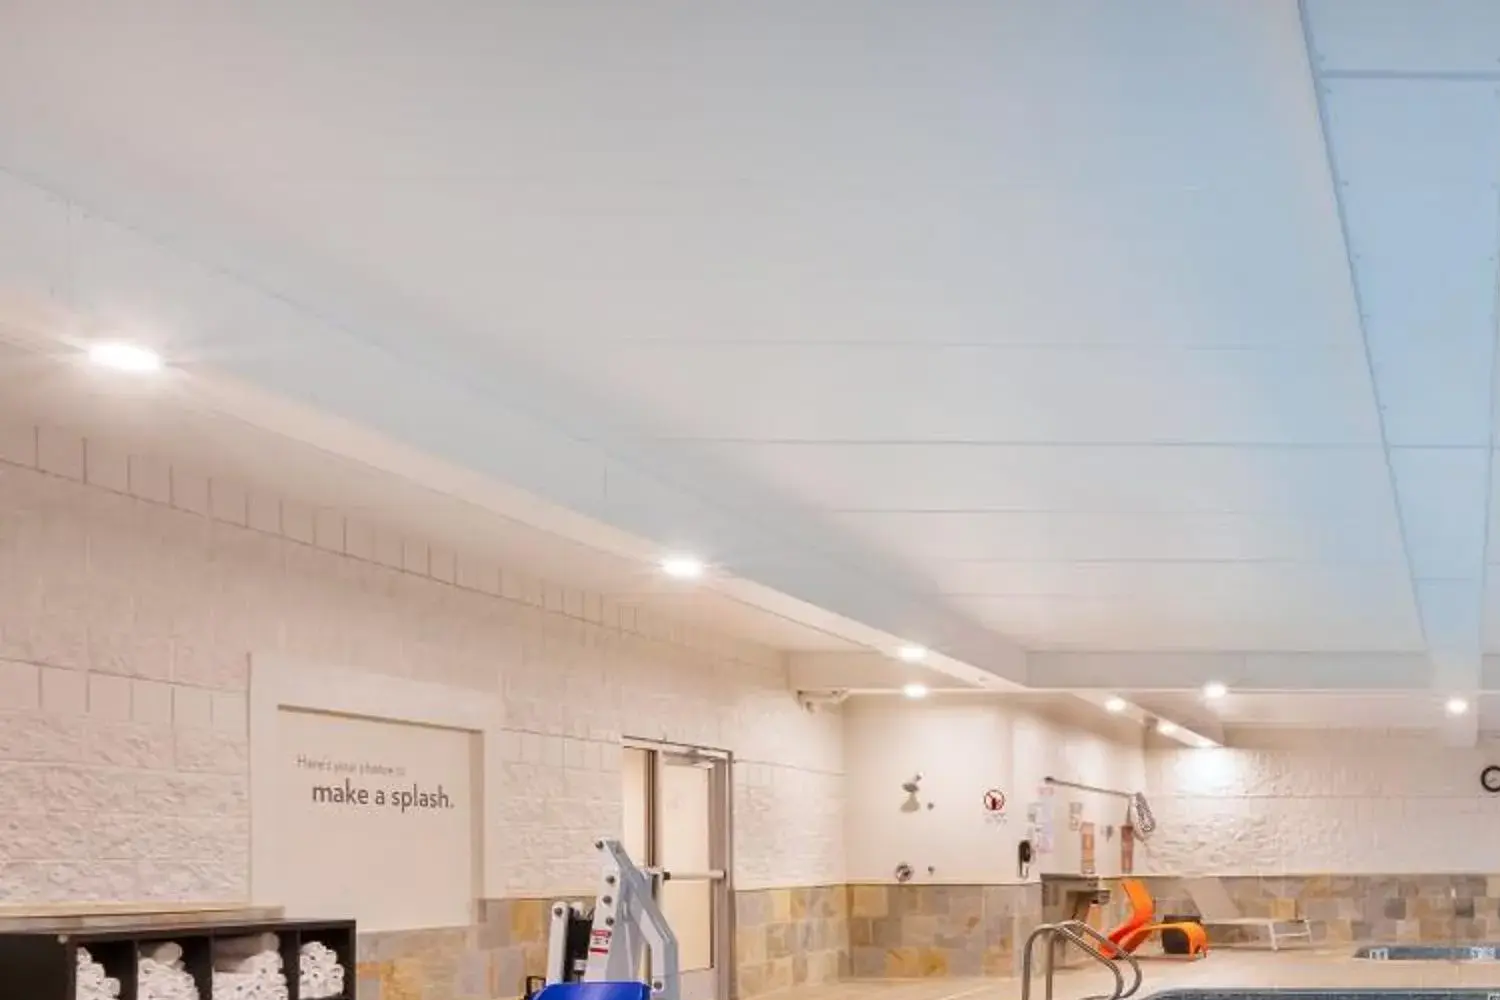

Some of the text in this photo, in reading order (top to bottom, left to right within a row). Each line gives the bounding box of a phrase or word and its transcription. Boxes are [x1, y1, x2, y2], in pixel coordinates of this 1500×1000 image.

[312, 777, 455, 813] make a splash.
